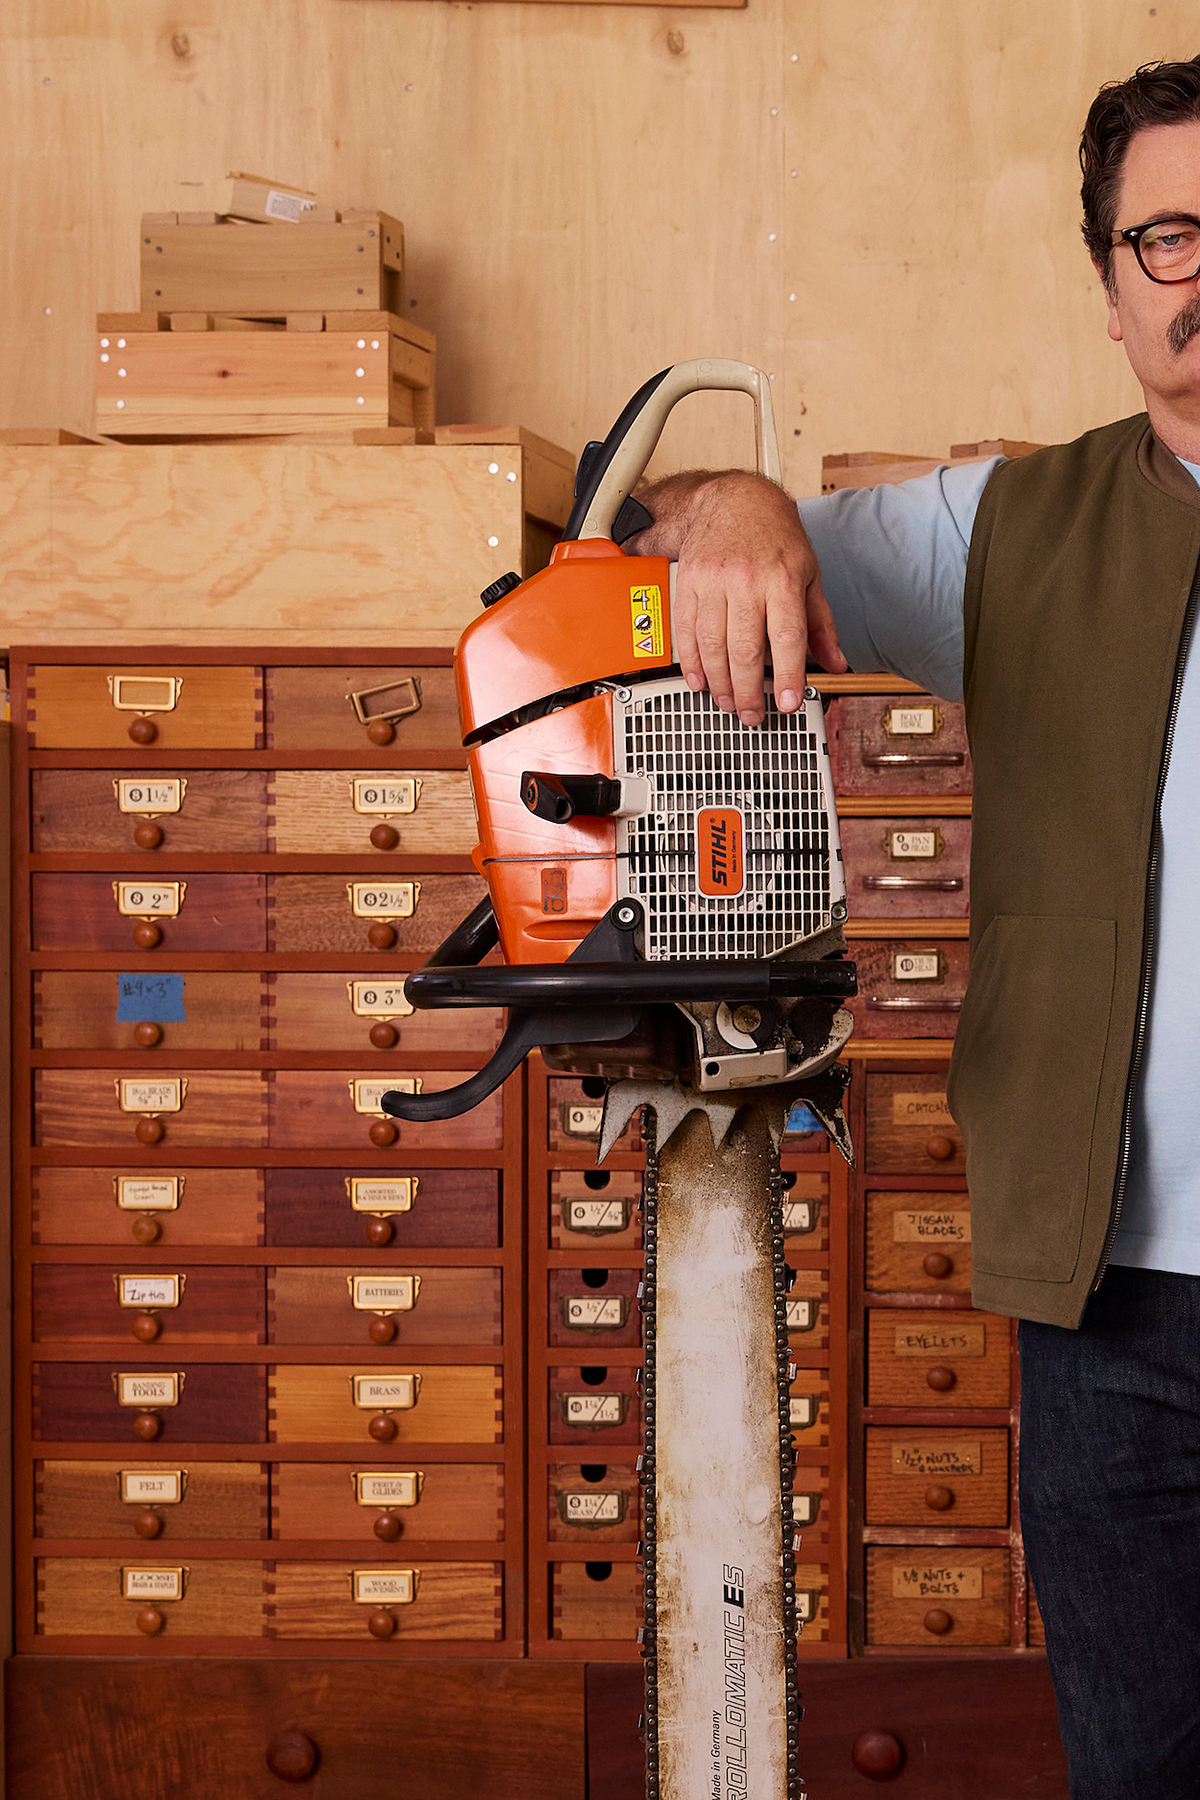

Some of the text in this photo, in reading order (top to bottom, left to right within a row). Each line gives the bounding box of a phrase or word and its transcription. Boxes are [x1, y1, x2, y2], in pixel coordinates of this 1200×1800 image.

[912, 836, 930, 844] PAN
[148, 1086, 172, 1095] BRADS
[907, 1213, 955, 1224] JIGSAW
[917, 1226, 965, 1240] BLADES
[127, 1289, 166, 1302] Zip ties
[365, 1288, 404, 1297] BATTERIES
[906, 1334, 968, 1348] EYELETS
[132, 1388, 166, 1397] TOOLS
[369, 1386, 401, 1396] BRASS
[926, 1452, 960, 1464] NUTS
[139, 1482, 165, 1491] FELT
[372, 1487, 402, 1496] GLIDES
[568, 1509, 594, 1517] BRASS
[924, 1568, 952, 1581] NUTS
[920, 1582, 960, 1595] BOLTS
[723, 1564, 748, 1800] ROLLOMATIC ES
[710, 1710, 722, 1800] Made in Germany
